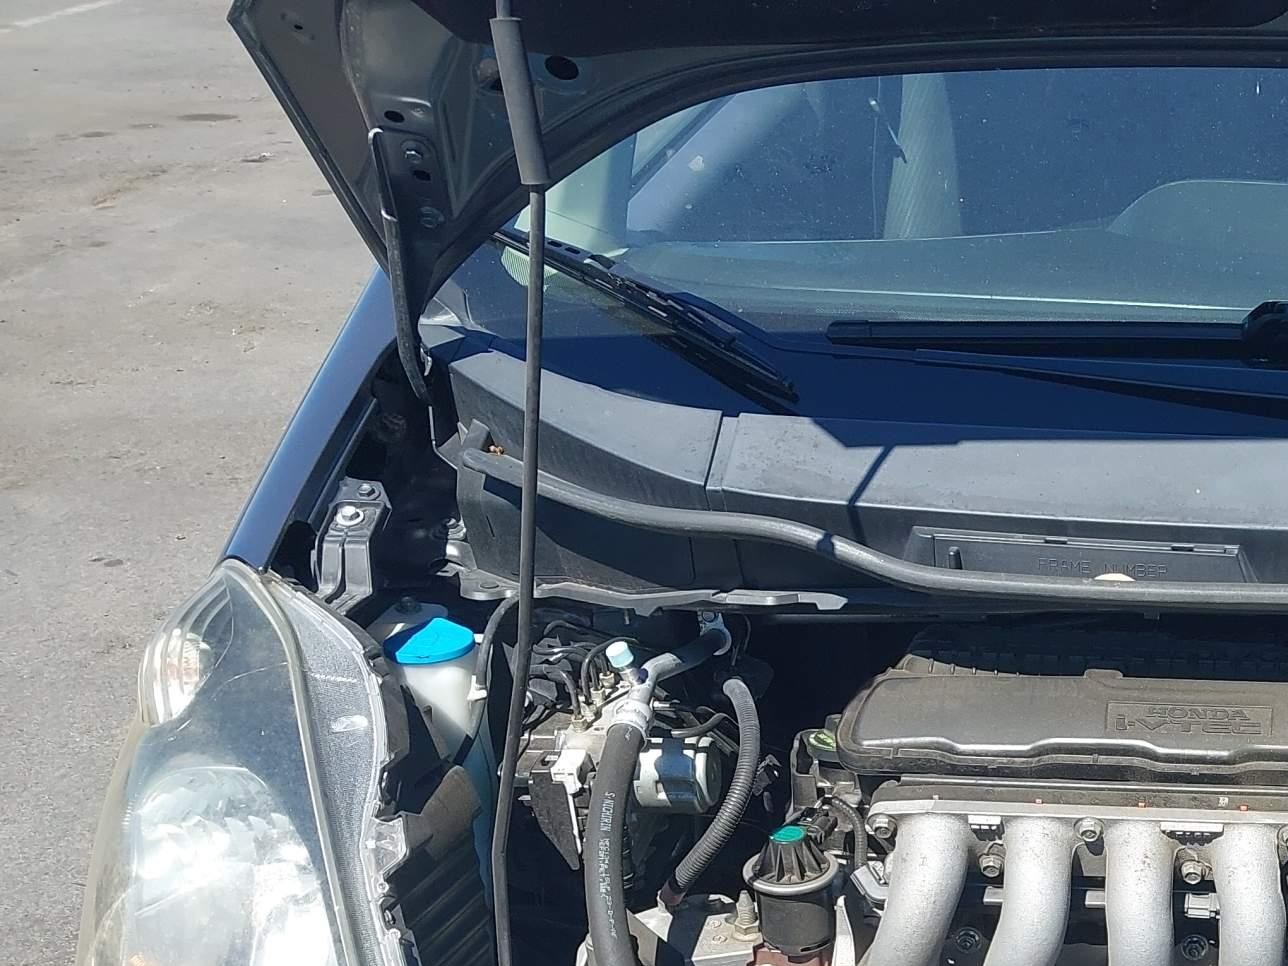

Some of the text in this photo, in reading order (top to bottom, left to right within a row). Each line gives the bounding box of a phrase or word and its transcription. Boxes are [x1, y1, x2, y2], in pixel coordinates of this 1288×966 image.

[1037, 557, 1169, 578] FRAME NUMBER
[1146, 706, 1251, 721] HONDA
